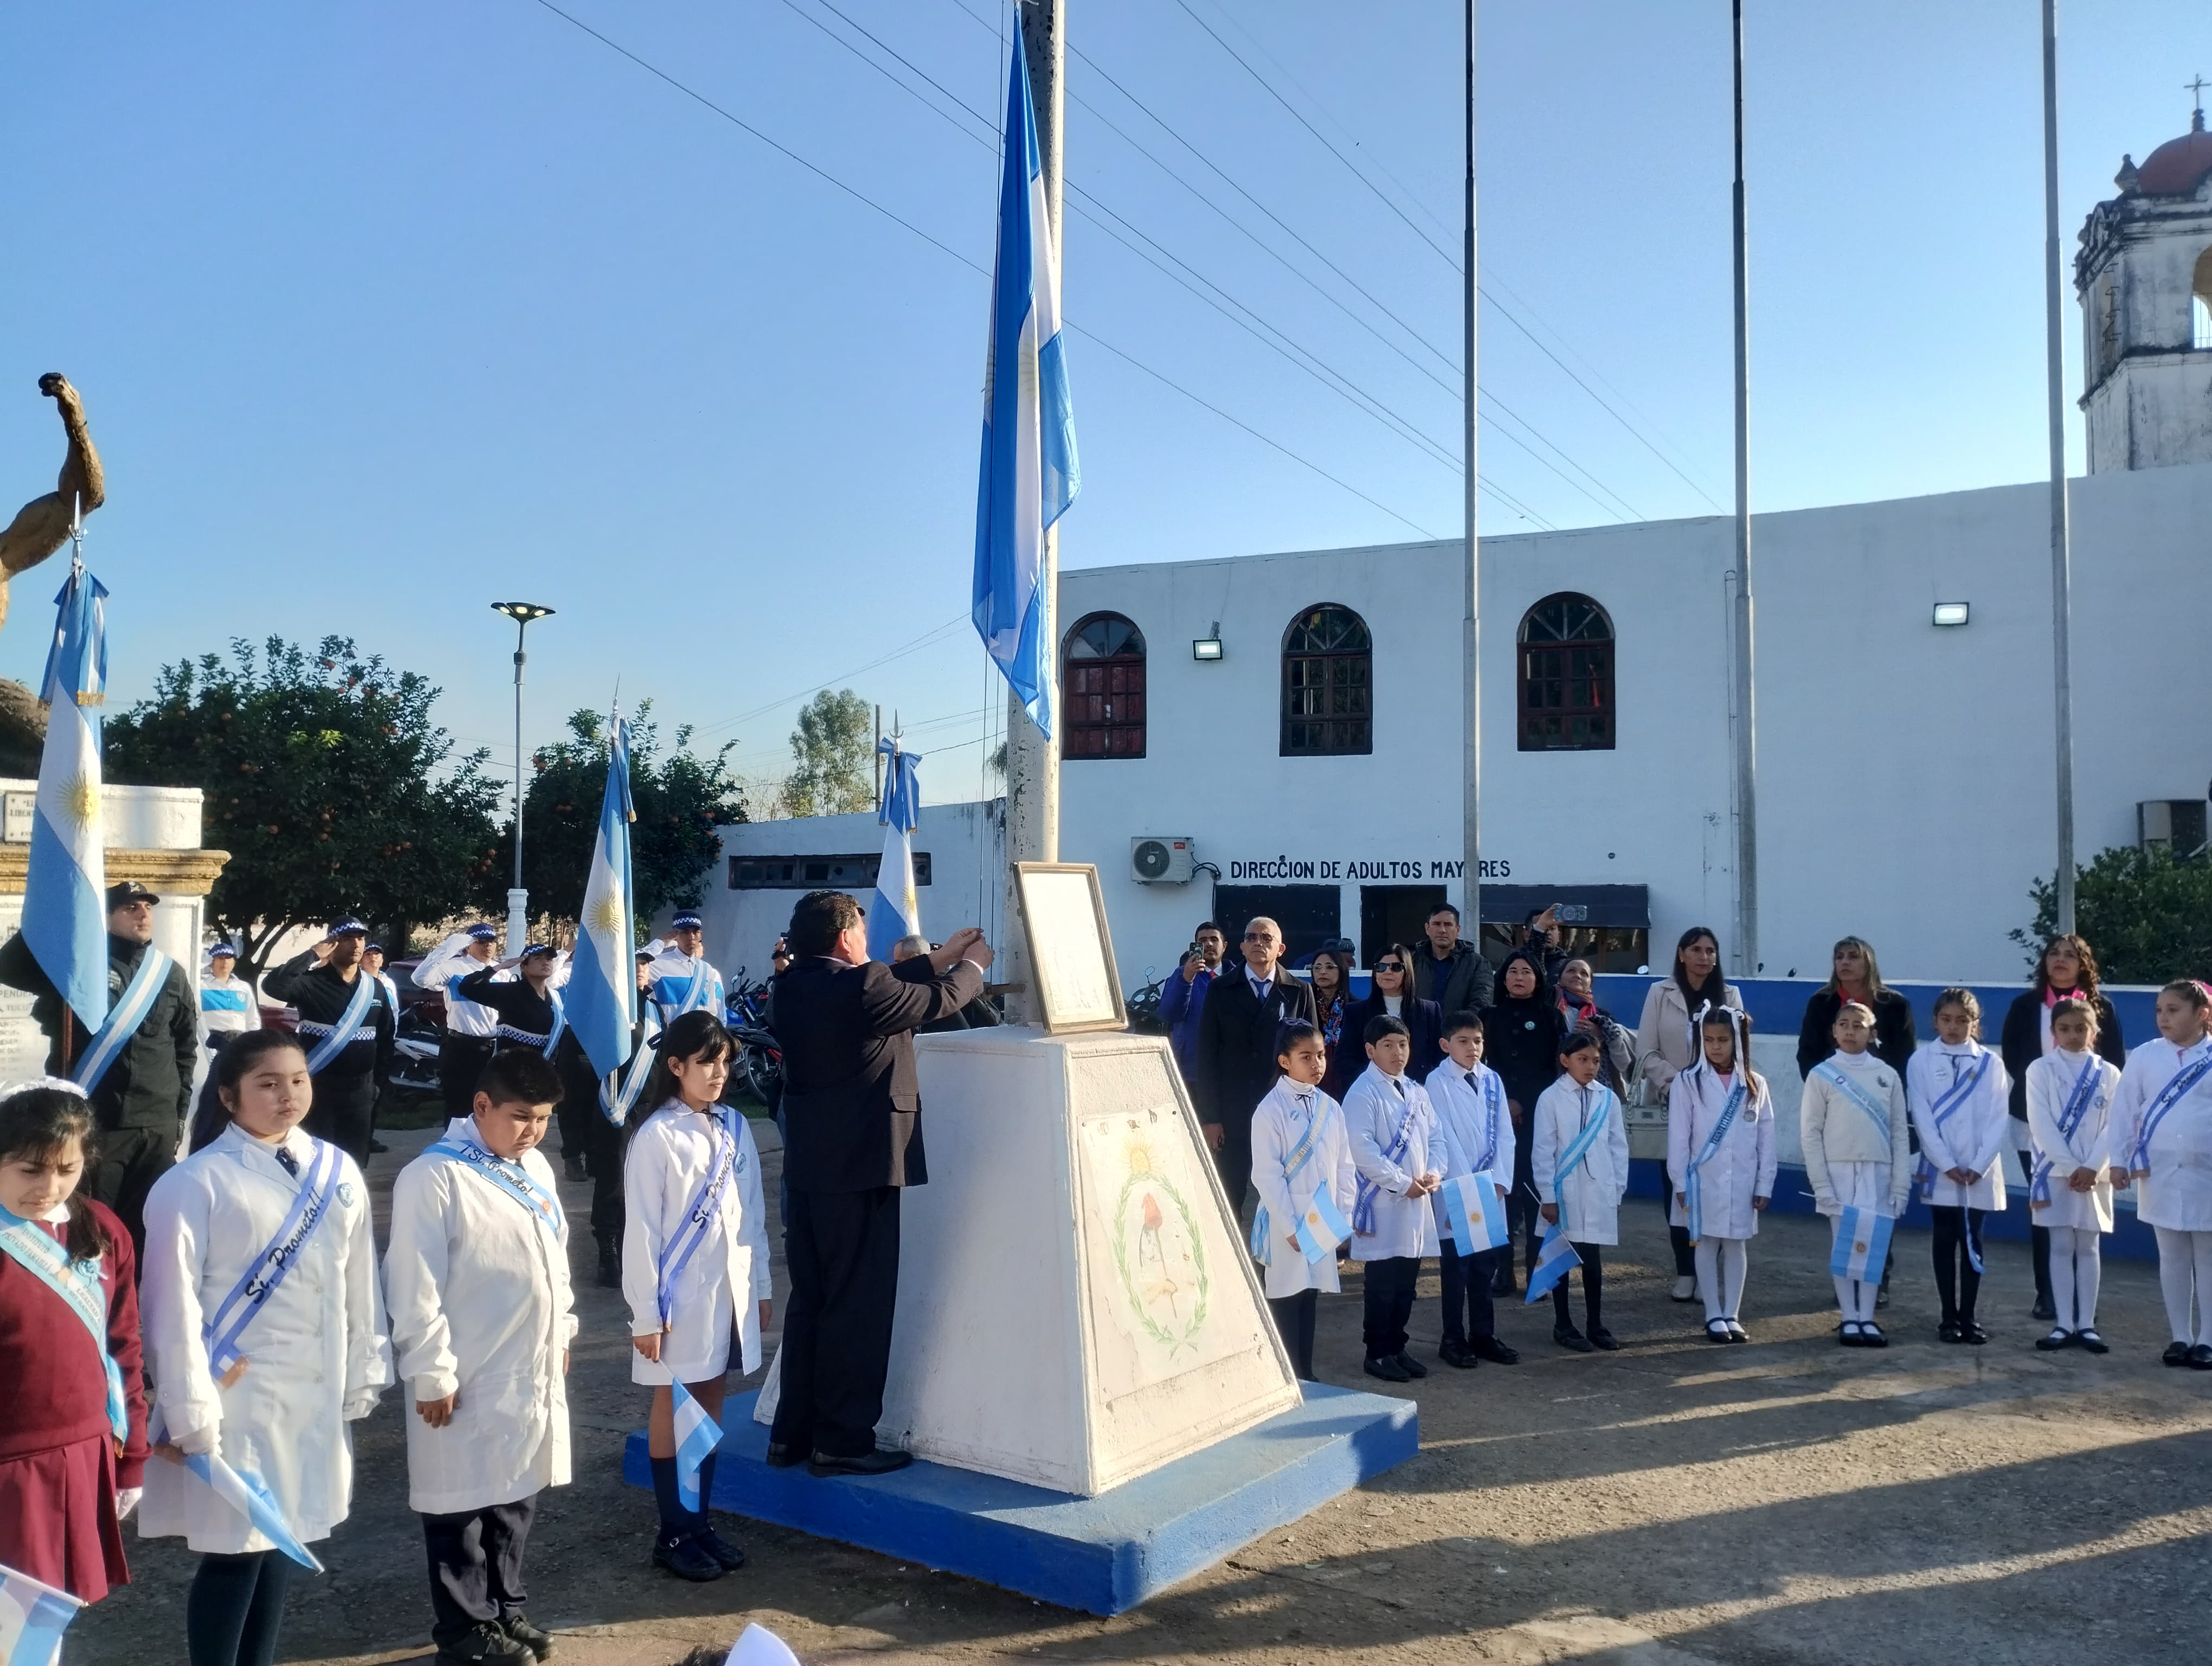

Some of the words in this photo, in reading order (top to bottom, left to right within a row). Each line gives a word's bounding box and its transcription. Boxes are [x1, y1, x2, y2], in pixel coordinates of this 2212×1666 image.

[1230, 861, 1315, 879] DIRECCION
[1320, 861, 1341, 879] DE
[1347, 861, 1423, 879] ADULTOS
[1431, 860, 1510, 879] MAYRES
